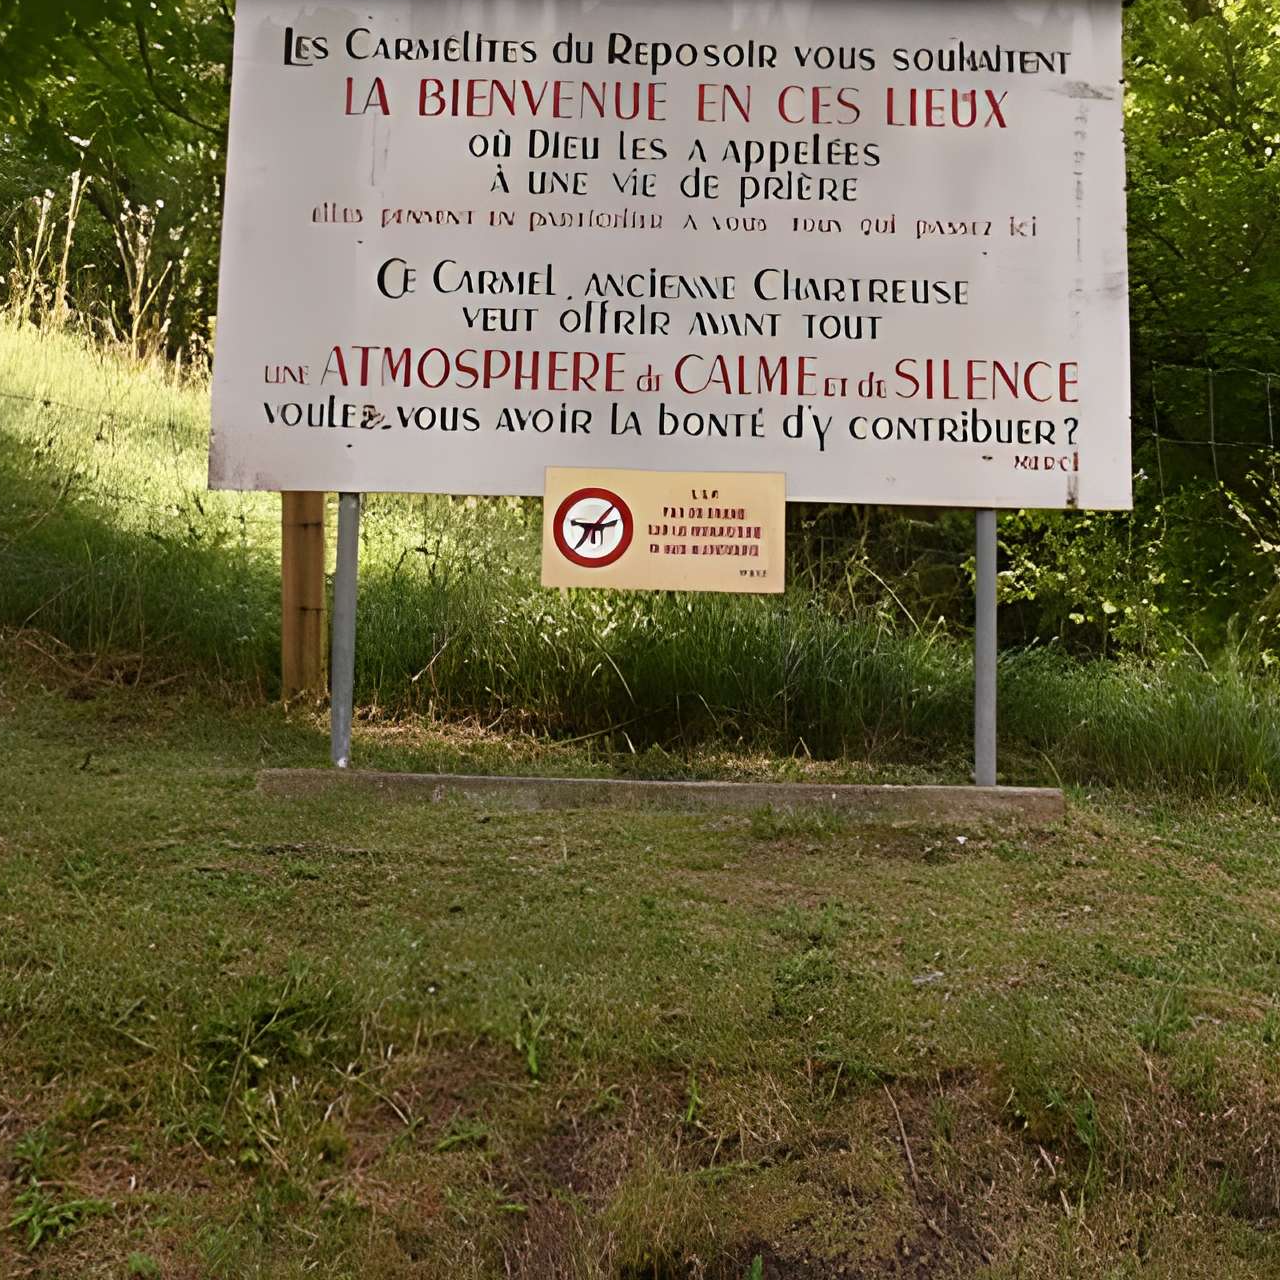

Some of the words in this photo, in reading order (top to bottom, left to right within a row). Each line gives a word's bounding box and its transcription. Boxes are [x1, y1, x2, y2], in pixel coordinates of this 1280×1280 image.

[553, 33, 593, 64] du
[345, 77, 390, 116] LA
[420, 78, 667, 121] BIENVENUE
[698, 83, 751, 122] EN
[778, 85, 860, 125] CES
[886, 87, 1008, 128] LIEUX
[529, 129, 599, 159] DIEU
[688, 139, 706, 163] A
[490, 164, 510, 194] À
[528, 171, 588, 195] UNE
[462, 307, 539, 332] VEUT
[802, 314, 883, 340] TOUT
[320, 345, 626, 392] ATMOSPHERE
[674, 353, 818, 396] CALME
[894, 358, 1078, 403] SILENCE
